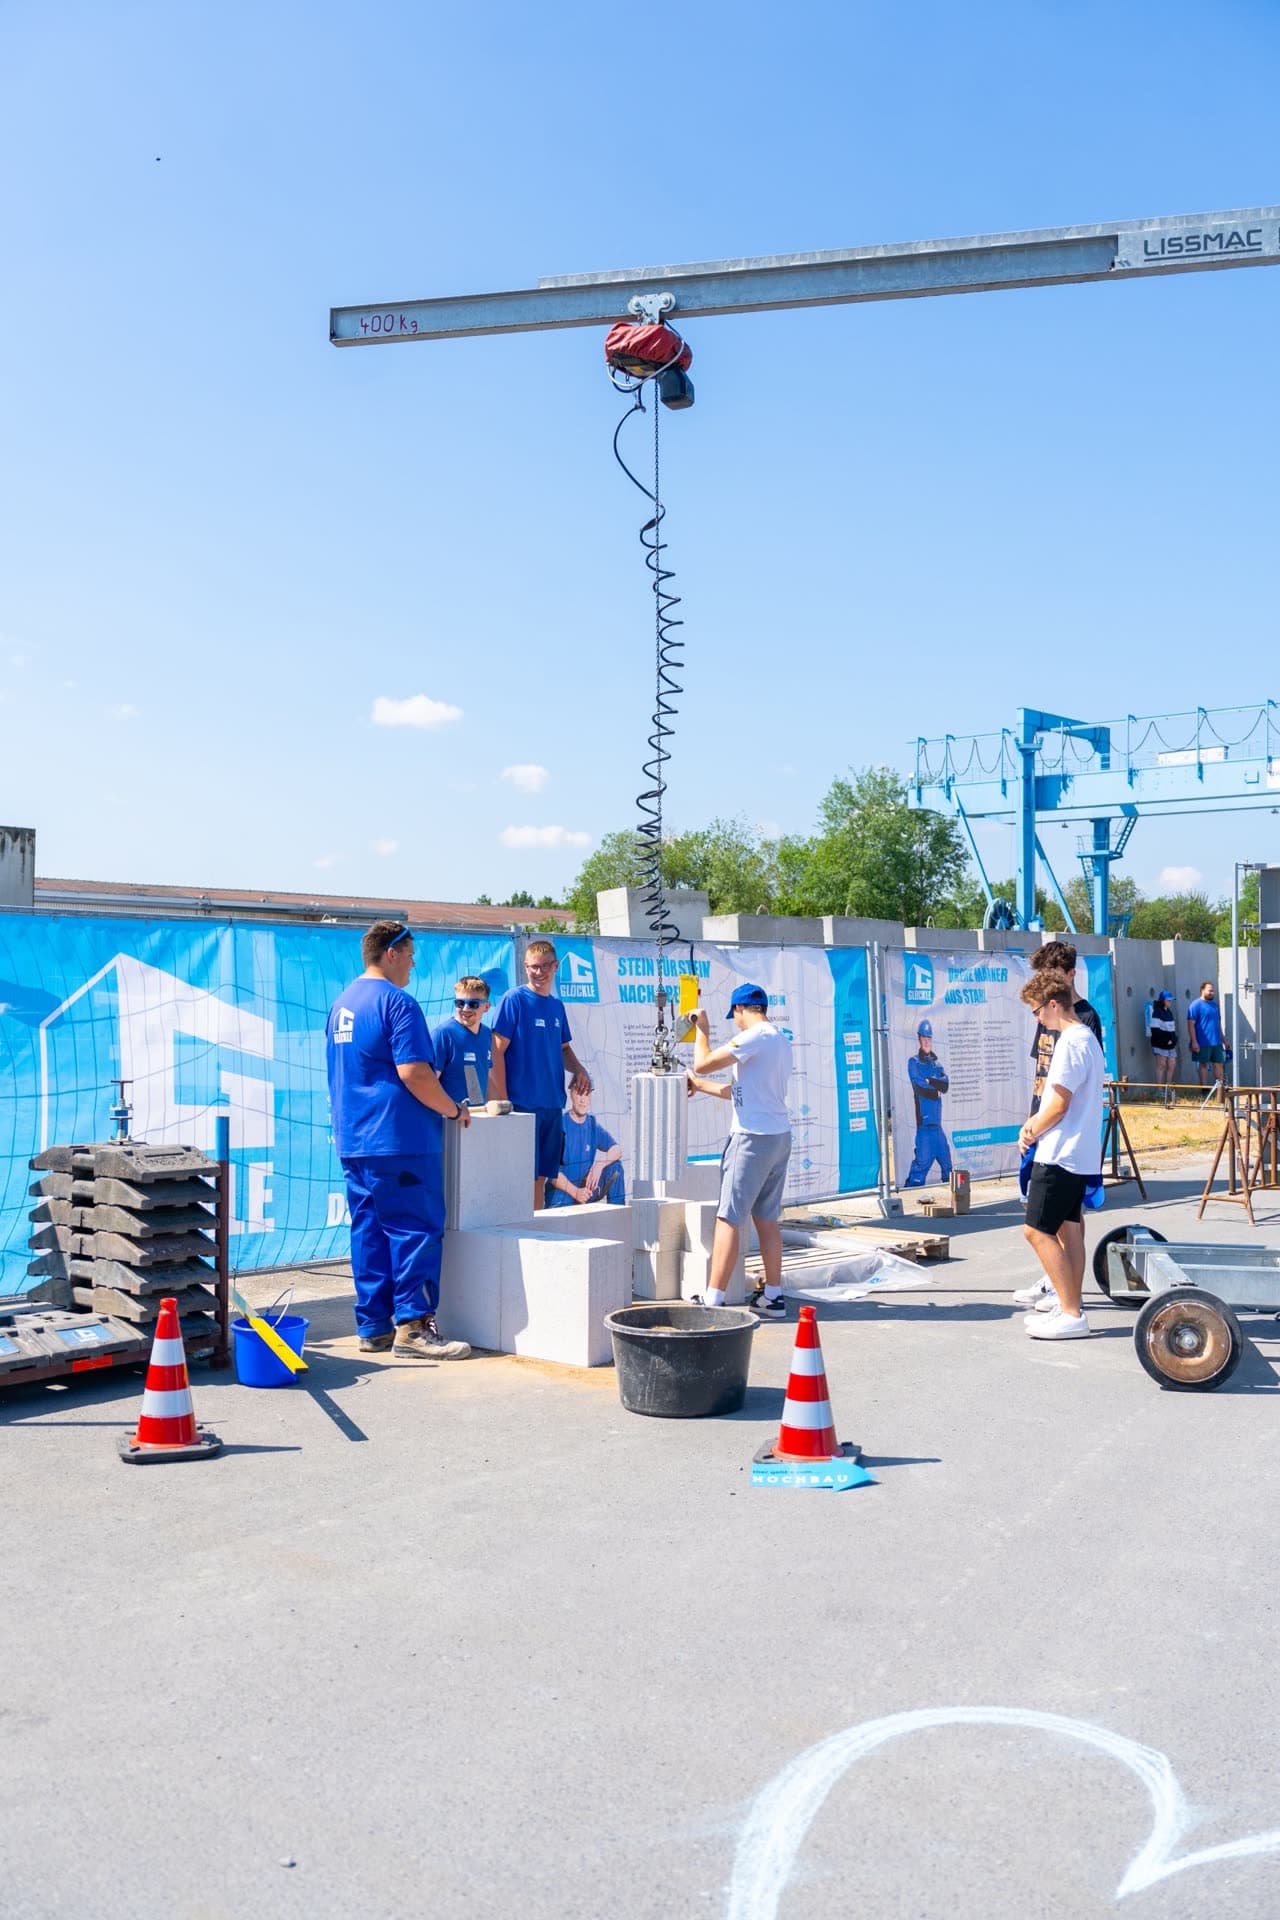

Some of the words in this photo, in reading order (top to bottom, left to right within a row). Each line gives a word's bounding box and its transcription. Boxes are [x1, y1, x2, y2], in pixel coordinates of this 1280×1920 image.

[1143, 229, 1262, 256] LISSMAC
[360, 314, 394, 334] 400
[617, 957, 654, 977] STEIN
[618, 984, 655, 1004] NACH
[752, 1474, 849, 1484] HOCHBAU
